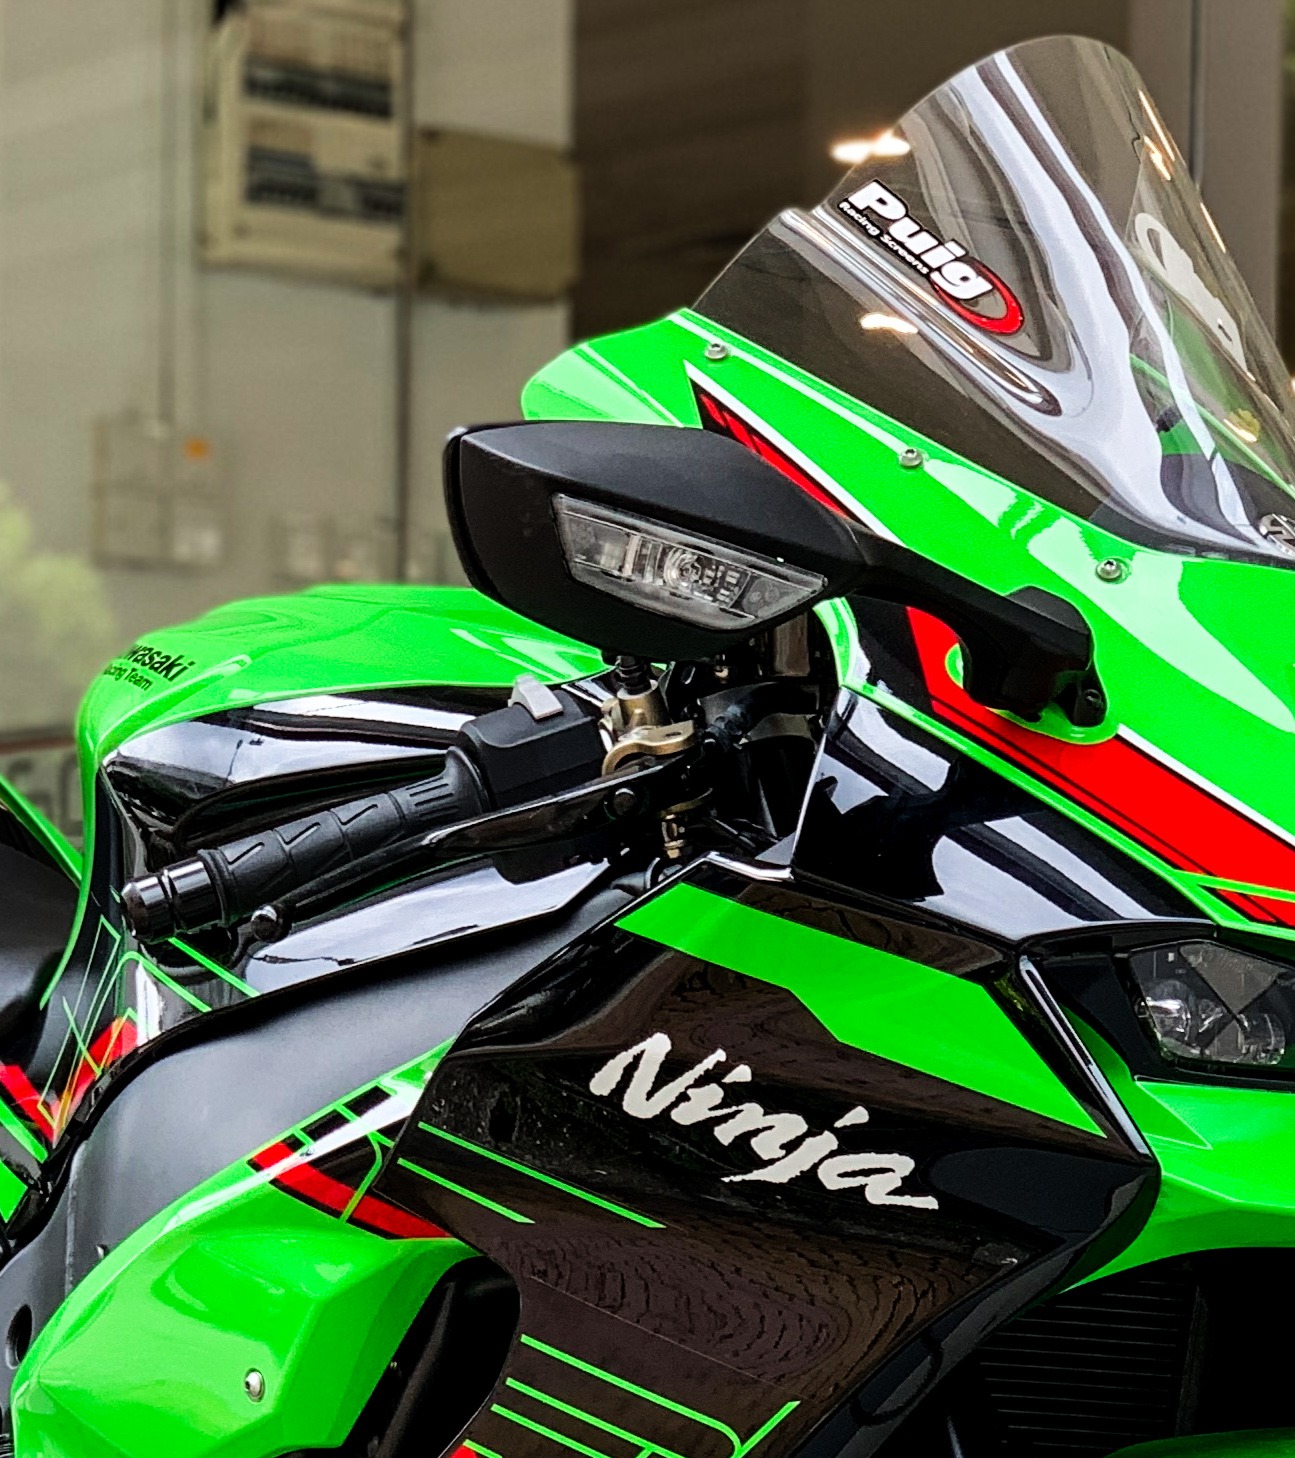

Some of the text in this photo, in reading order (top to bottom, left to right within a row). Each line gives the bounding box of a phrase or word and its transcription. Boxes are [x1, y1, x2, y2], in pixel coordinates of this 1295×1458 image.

[838, 202, 930, 276] Racing Screens
[848, 181, 994, 300] Puig
[124, 667, 155, 691] Team
[589, 1032, 940, 1211] Ninja
